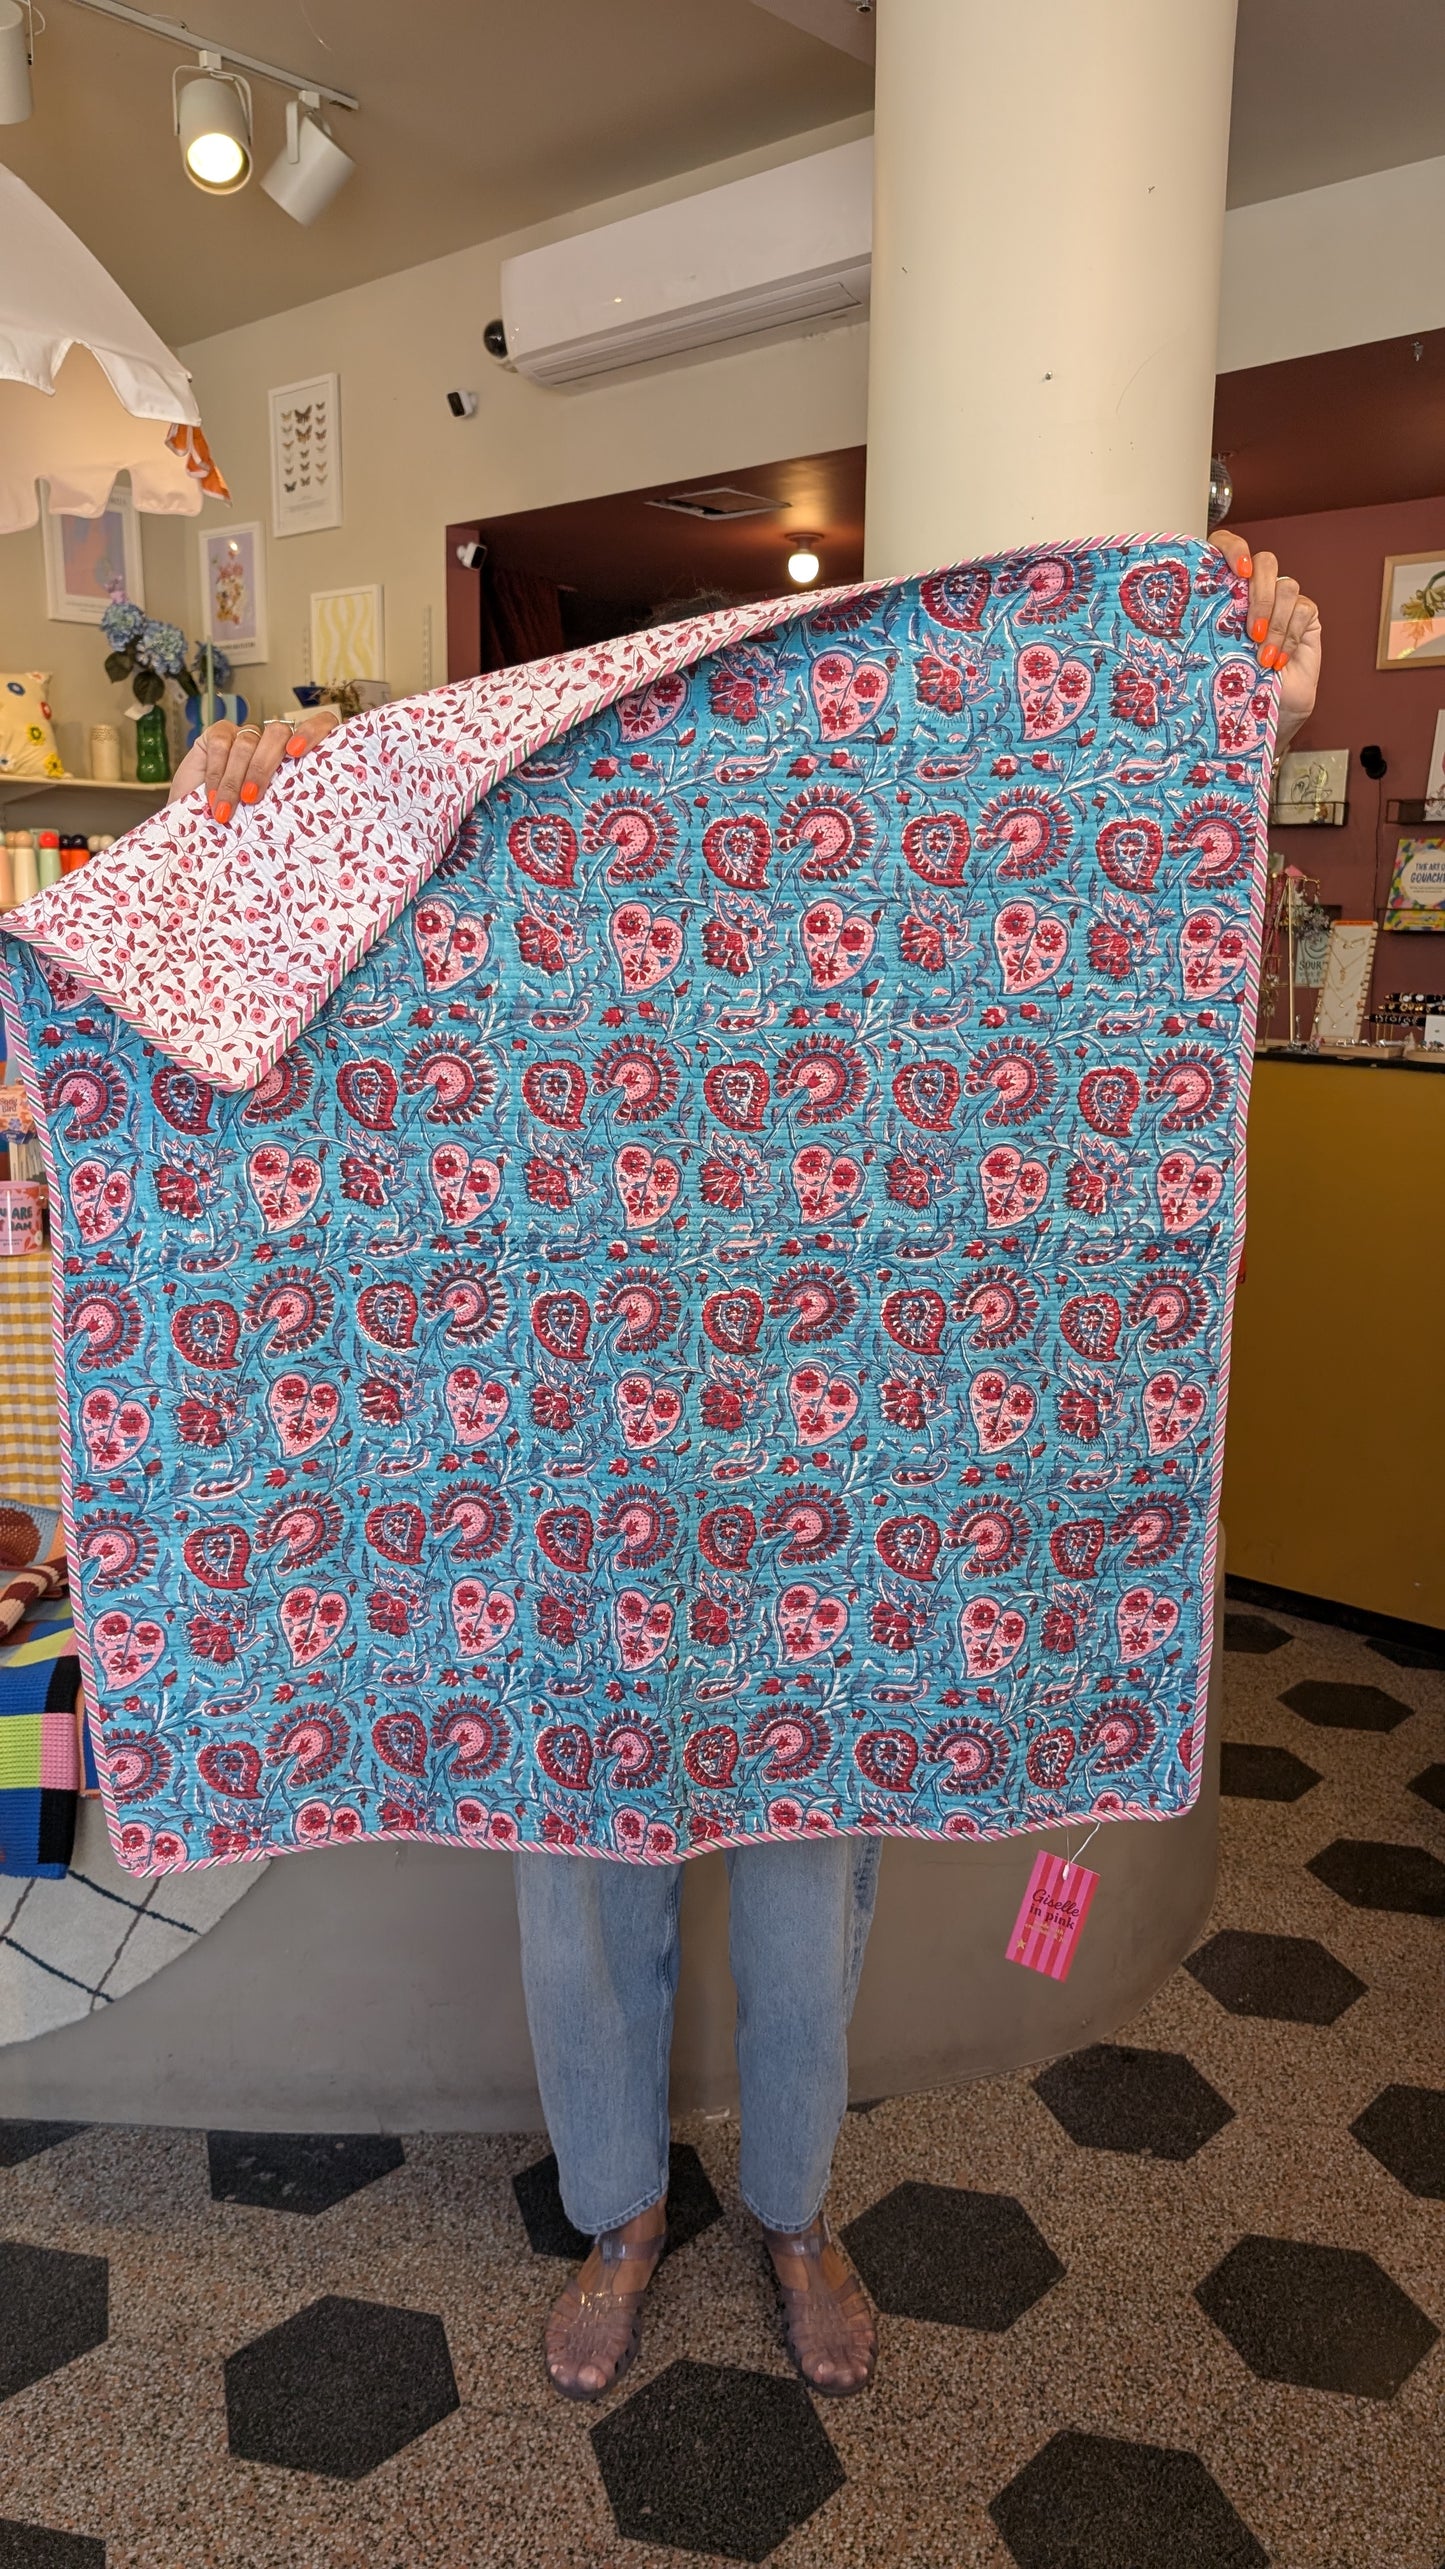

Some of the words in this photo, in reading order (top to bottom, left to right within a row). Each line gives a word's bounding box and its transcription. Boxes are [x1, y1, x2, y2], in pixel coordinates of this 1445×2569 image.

[12, 1206, 33, 1220] ARE
[1032, 1888, 1080, 1917] Giselle
[1030, 1903, 1042, 1917] in
[1045, 1912, 1075, 1930] pink
